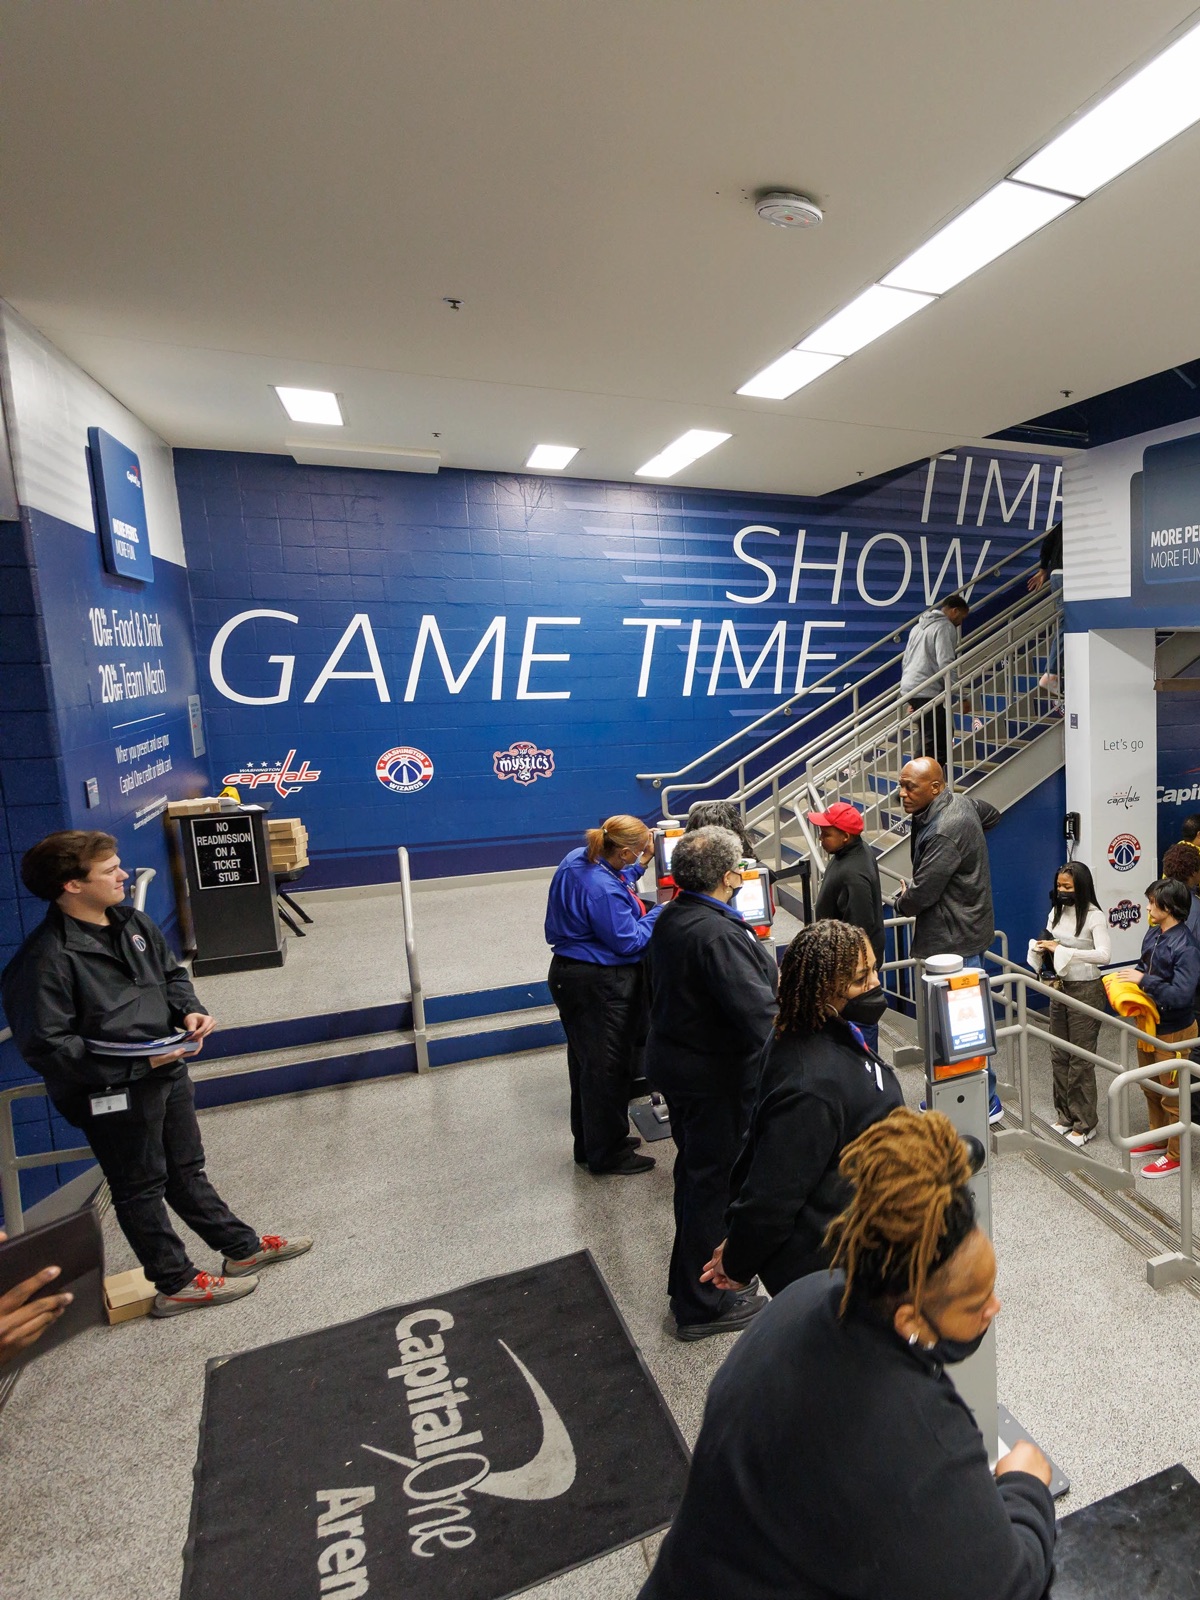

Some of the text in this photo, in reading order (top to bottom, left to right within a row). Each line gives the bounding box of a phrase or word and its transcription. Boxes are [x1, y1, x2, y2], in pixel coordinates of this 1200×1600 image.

[1151, 527, 1183, 548] MORE
[726, 525, 992, 607] SHOW
[1151, 549, 1180, 569] MORE
[112, 609, 137, 647] Food
[135, 612, 145, 647] &
[143, 613, 164, 647] Drink
[208, 608, 582, 706] GAME
[120, 663, 145, 699] Team
[143, 659, 167, 696] Merch
[1103, 738, 1144, 752] Let's go
[381, 748, 426, 762] WASHINGTON
[389, 780, 424, 791] WIZARDS
[216, 822, 229, 833] NO
[196, 832, 252, 846] READMISSION
[215, 846, 237, 857] ON A
[213, 858, 241, 870] TICKET
[218, 871, 240, 883] STUB
